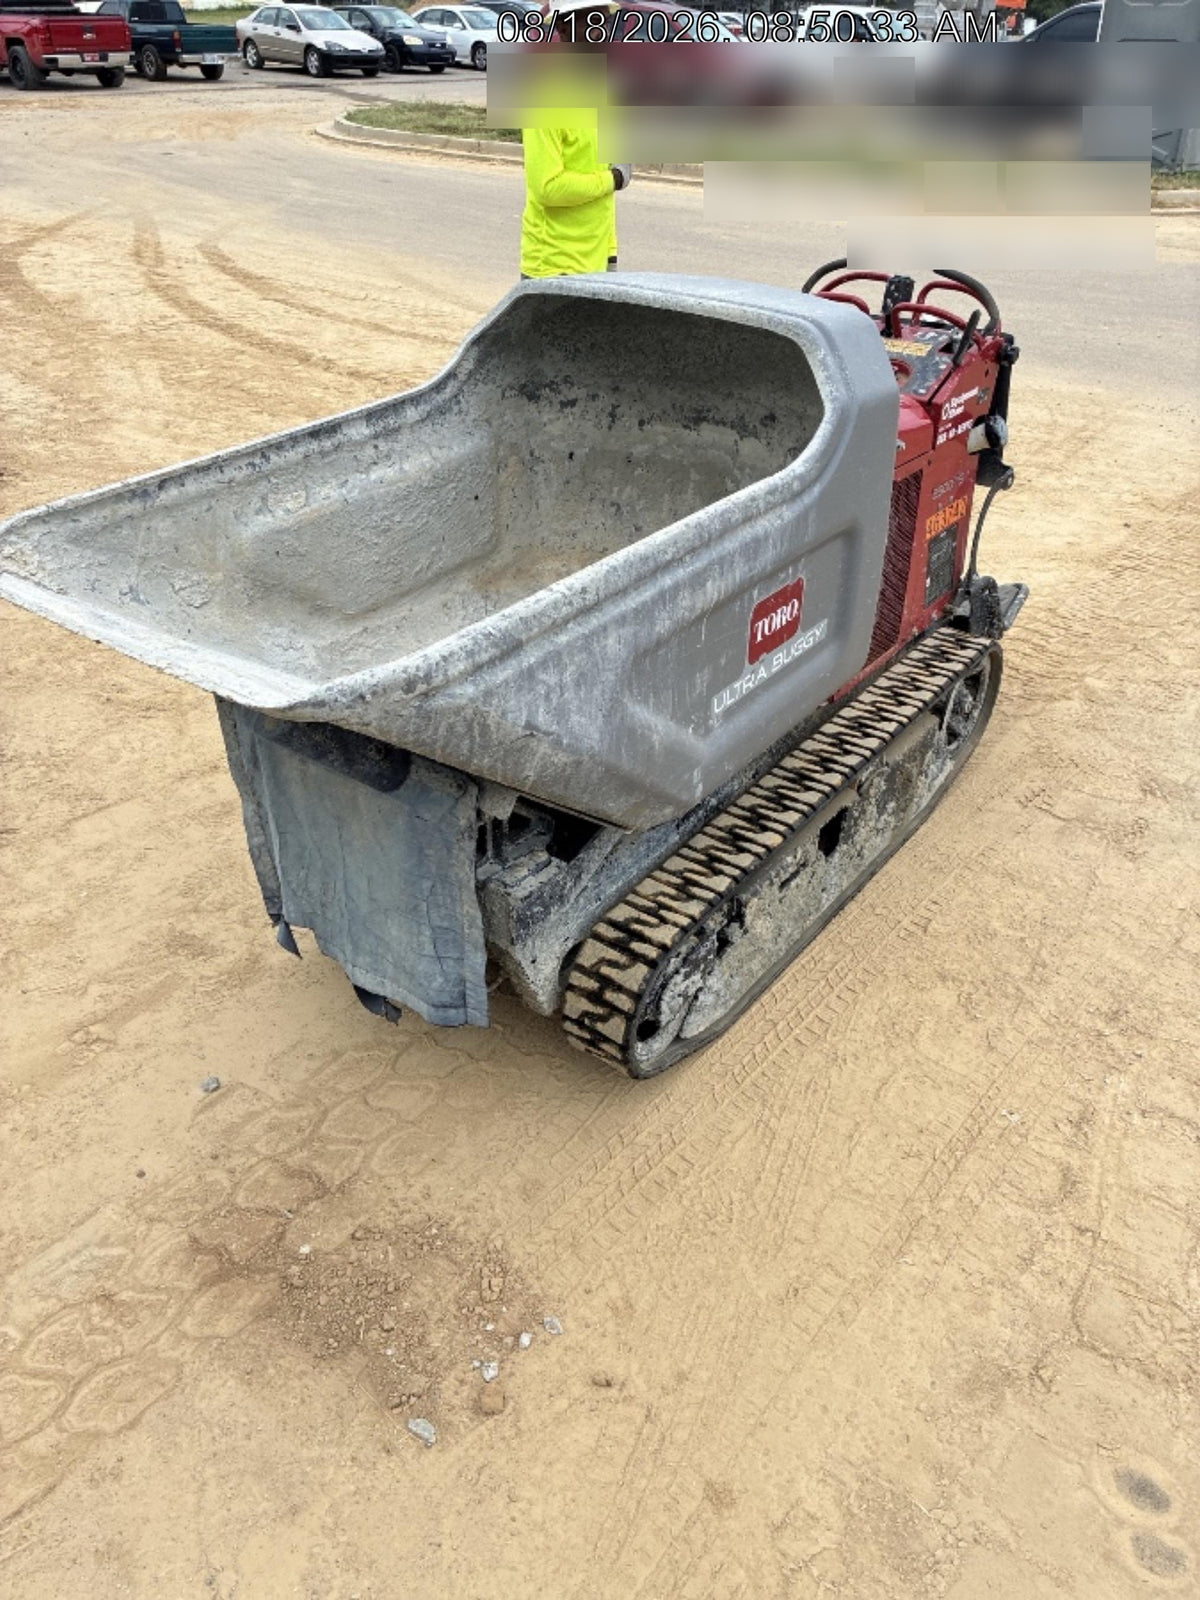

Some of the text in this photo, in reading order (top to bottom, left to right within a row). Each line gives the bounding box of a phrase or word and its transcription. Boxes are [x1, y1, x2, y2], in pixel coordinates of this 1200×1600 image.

[754, 598, 800, 644] TORO
[713, 618, 828, 714] ULTRA BUGGY
